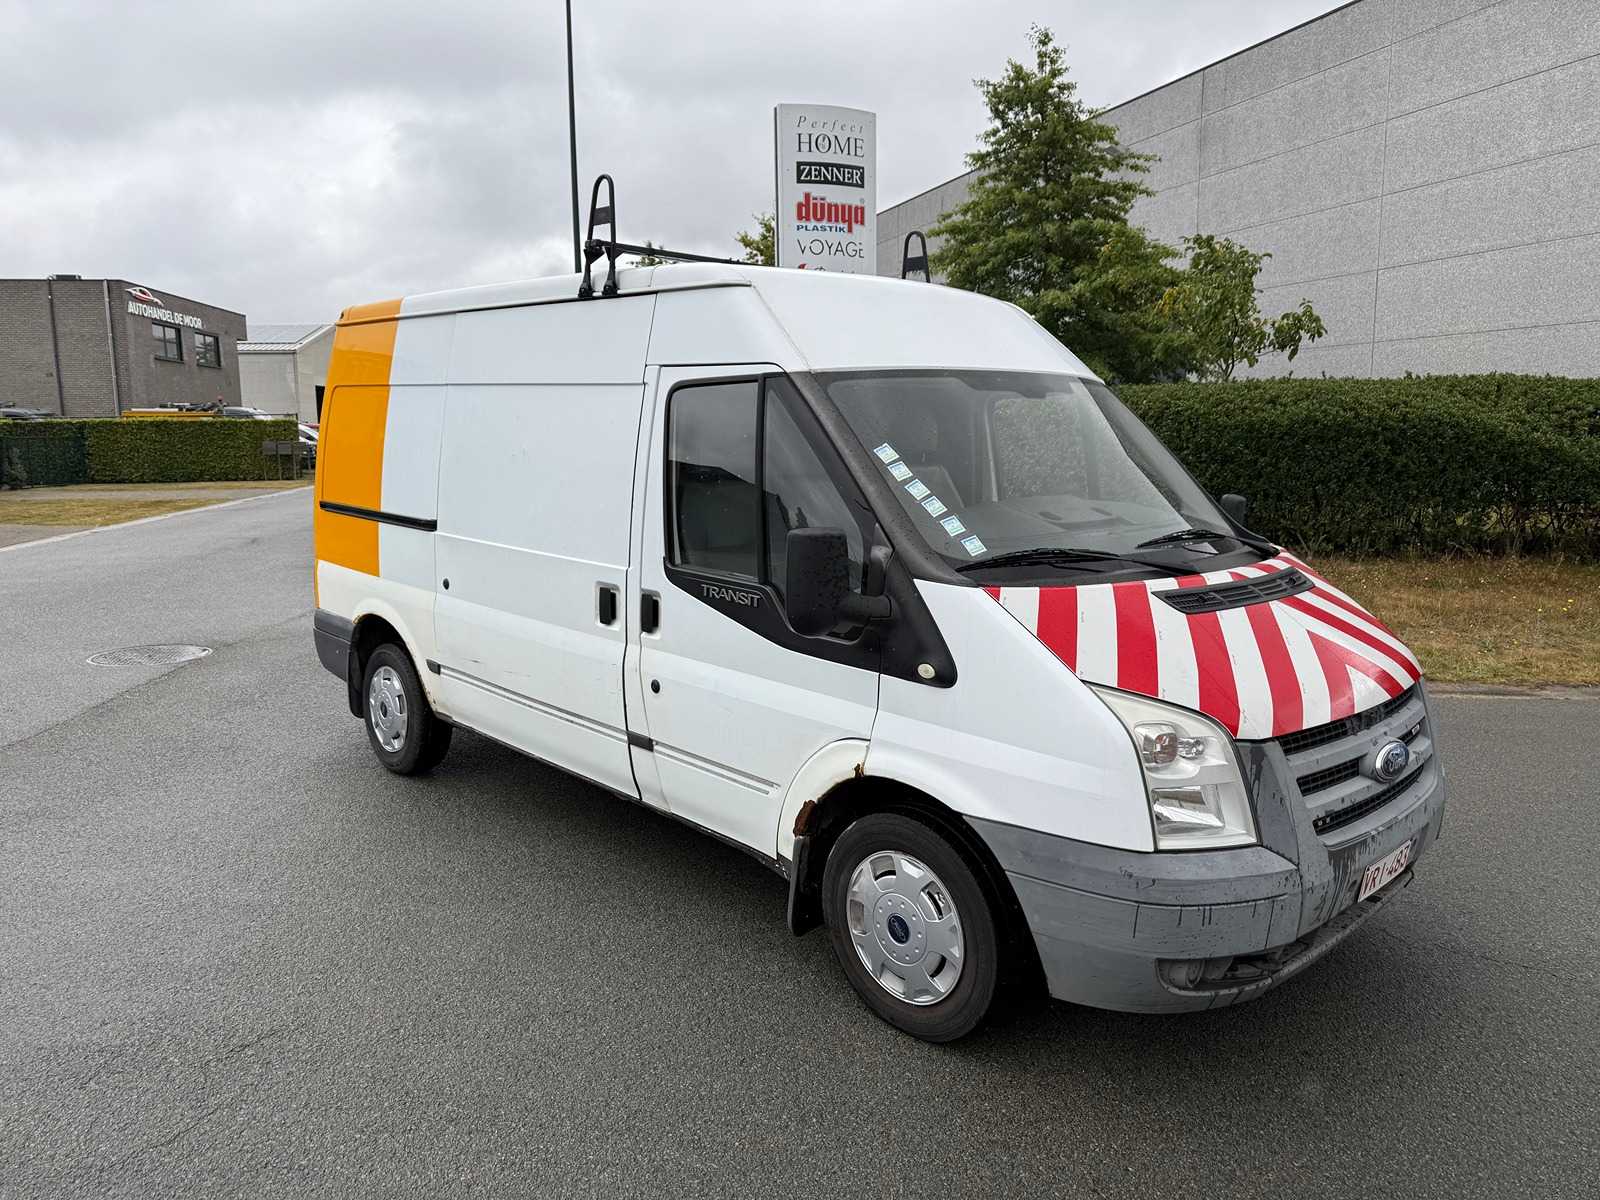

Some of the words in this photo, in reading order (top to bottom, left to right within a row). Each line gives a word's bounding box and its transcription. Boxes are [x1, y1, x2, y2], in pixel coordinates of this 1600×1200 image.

[797, 115, 863, 133] Perfect
[797, 132, 864, 158] HOME
[799, 165, 863, 185] ZENNER
[797, 192, 865, 233] dünya
[797, 238, 865, 259] VOYAGE
[127, 301, 174, 323] AUTOHANDEL
[174, 312, 183, 325] DE
[183, 314, 203, 330] MOOR
[701, 584, 761, 608] TRANSIT
